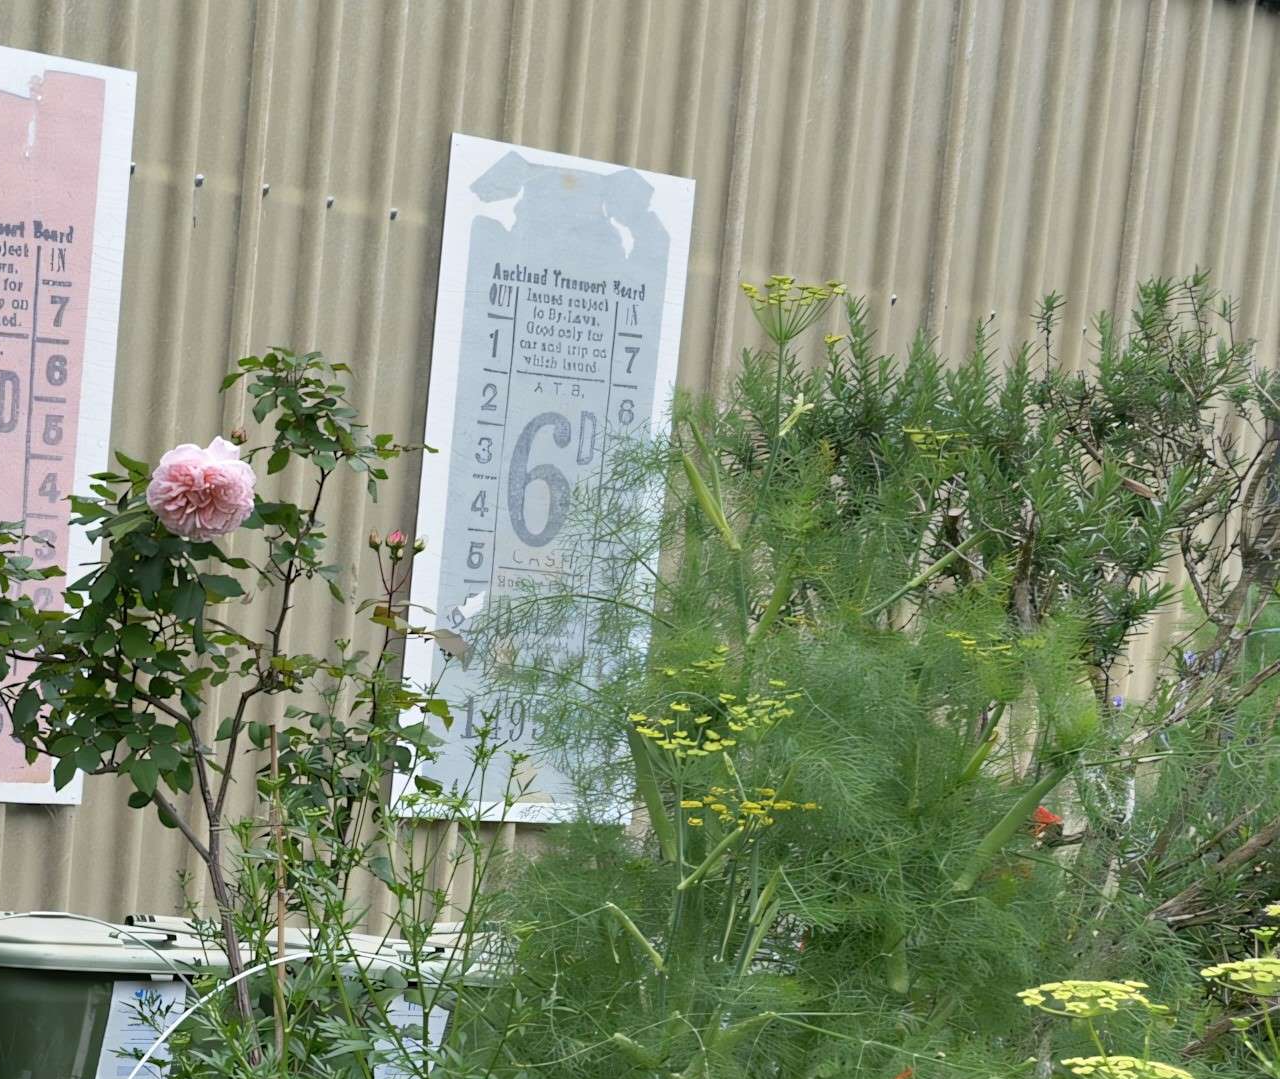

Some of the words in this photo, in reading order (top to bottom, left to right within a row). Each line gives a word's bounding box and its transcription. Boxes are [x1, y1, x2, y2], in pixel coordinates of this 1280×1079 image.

[34, 221, 73, 244] Board
[50, 248, 66, 272] IN
[4, 278, 23, 293] for
[493, 262, 547, 285] Auckland
[553, 269, 606, 295] Transport
[11, 299, 28, 311] on
[50, 295, 70, 328] 7
[527, 321, 555, 337] Good
[490, 329, 498, 357] 1
[46, 354, 68, 387] 6
[625, 347, 640, 373] 7
[481, 383, 497, 411] 2
[42, 415, 64, 445] 5
[476, 437, 492, 463] 3
[38, 472, 61, 505] 4
[471, 490, 488, 517] 4
[467, 541, 484, 570] 5
